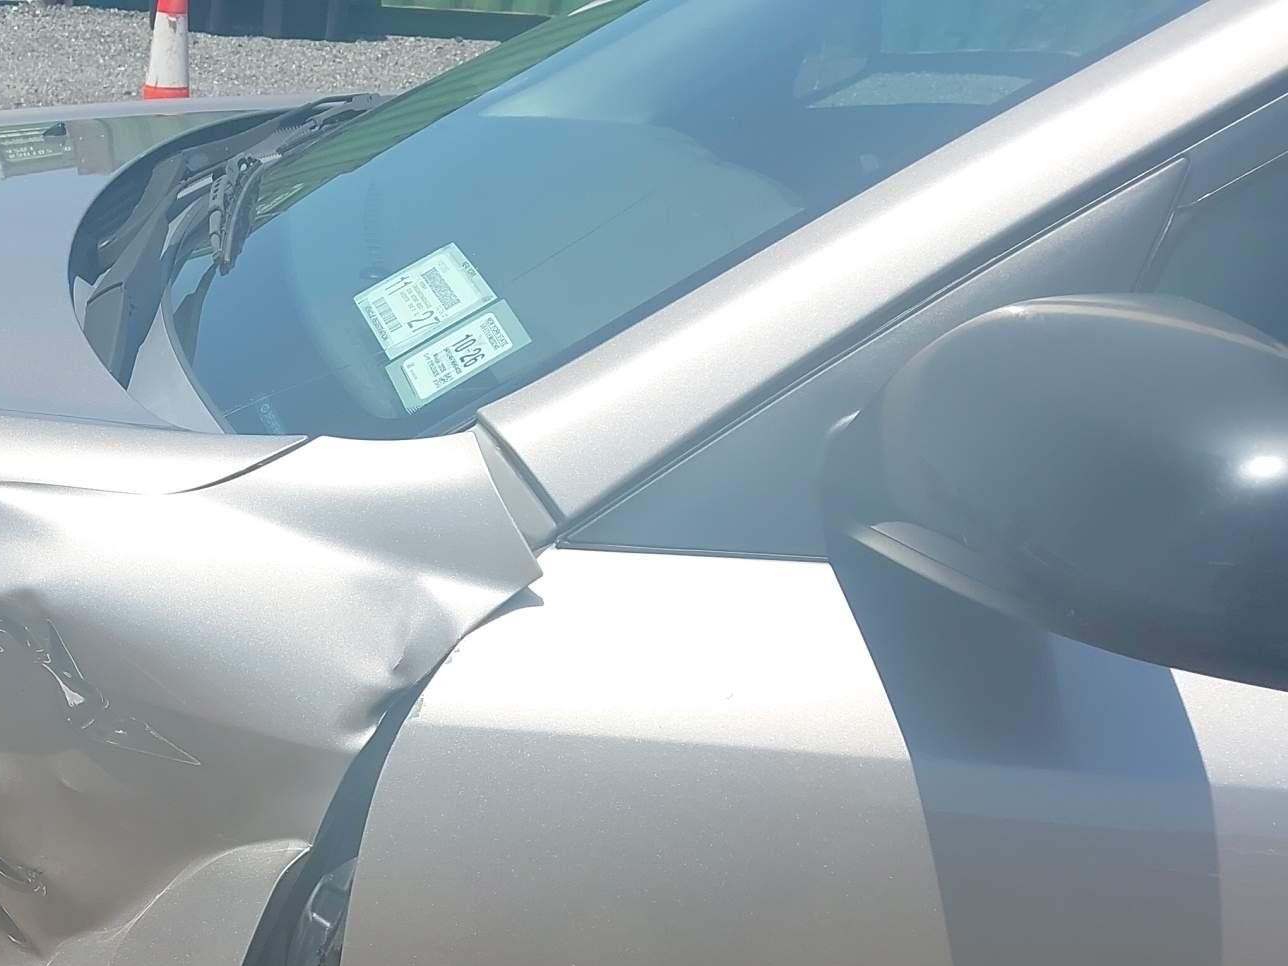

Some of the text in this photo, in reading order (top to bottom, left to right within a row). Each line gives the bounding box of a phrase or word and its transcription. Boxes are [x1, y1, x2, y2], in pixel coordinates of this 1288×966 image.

[385, 276, 413, 296] 11
[407, 310, 441, 333] 27
[452, 334, 485, 368] 10-26
